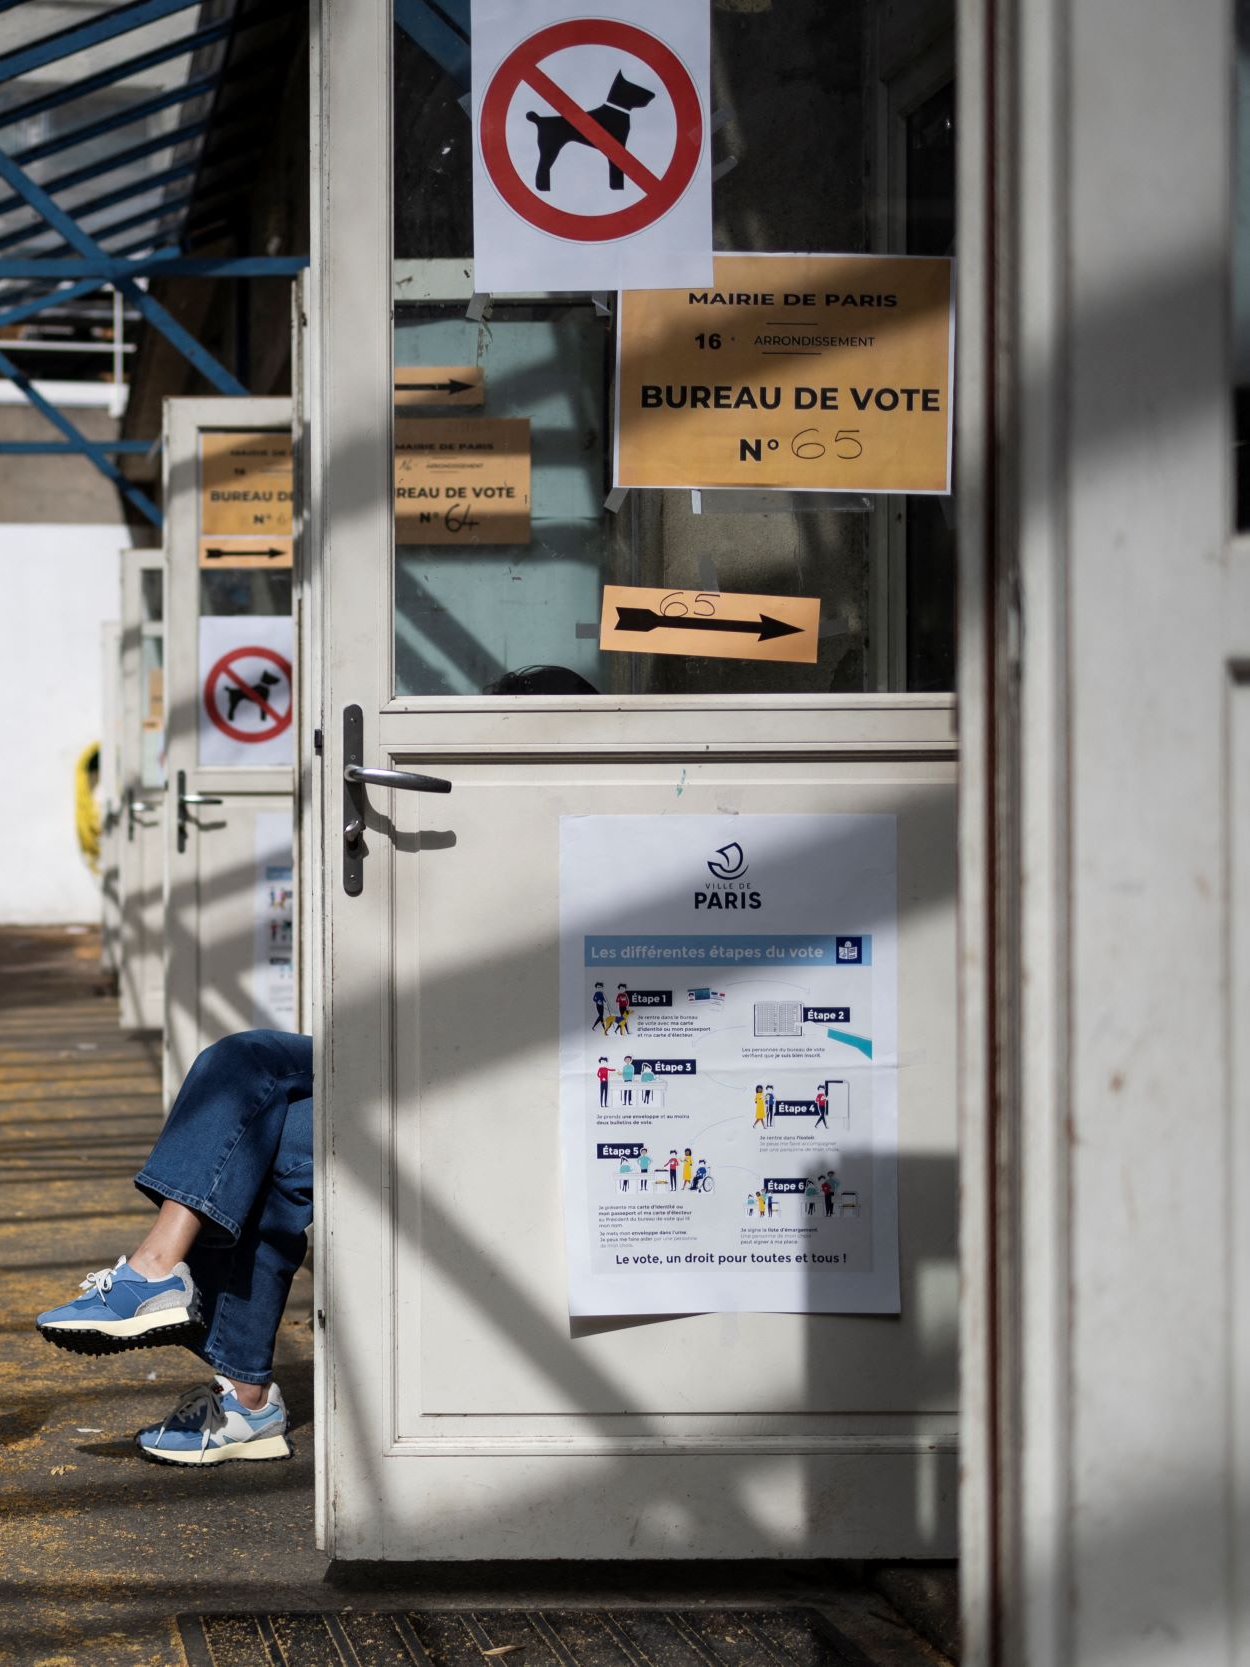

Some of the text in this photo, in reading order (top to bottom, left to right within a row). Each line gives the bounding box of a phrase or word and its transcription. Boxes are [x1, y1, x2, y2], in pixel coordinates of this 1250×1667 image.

[688, 292, 898, 308] MAIRIE DE PARIS
[754, 335, 876, 348] ARRONDISSEMENT
[641, 385, 940, 412] BUREAU DE VOTE
[739, 428, 863, 462] N° 65
[210, 490, 272, 502] BUREAU
[396, 487, 516, 498] REAU DE VOTE
[444, 504, 479, 532] 64
[660, 592, 720, 617] 65
[694, 892, 762, 910] PARIS
[591, 946, 824, 962] Les différentes étapes du vote
[631, 992, 666, 1004] Étape 1
[808, 1009, 844, 1021] Étape 2
[654, 1062, 692, 1074] Étape 3
[778, 1102, 816, 1114] Étape 4
[602, 1146, 639, 1158] Étape 5
[768, 1180, 805, 1192] Étape 6
[616, 1254, 629, 1264] Le
[632, 1254, 662, 1265] vote,
[666, 1255, 681, 1264] un
[684, 1252, 714, 1264] droit
[718, 1254, 747, 1266] pour
[750, 1253, 791, 1263] toutes
[795, 1253, 808, 1263] et
[811, 1253, 839, 1263] tous
